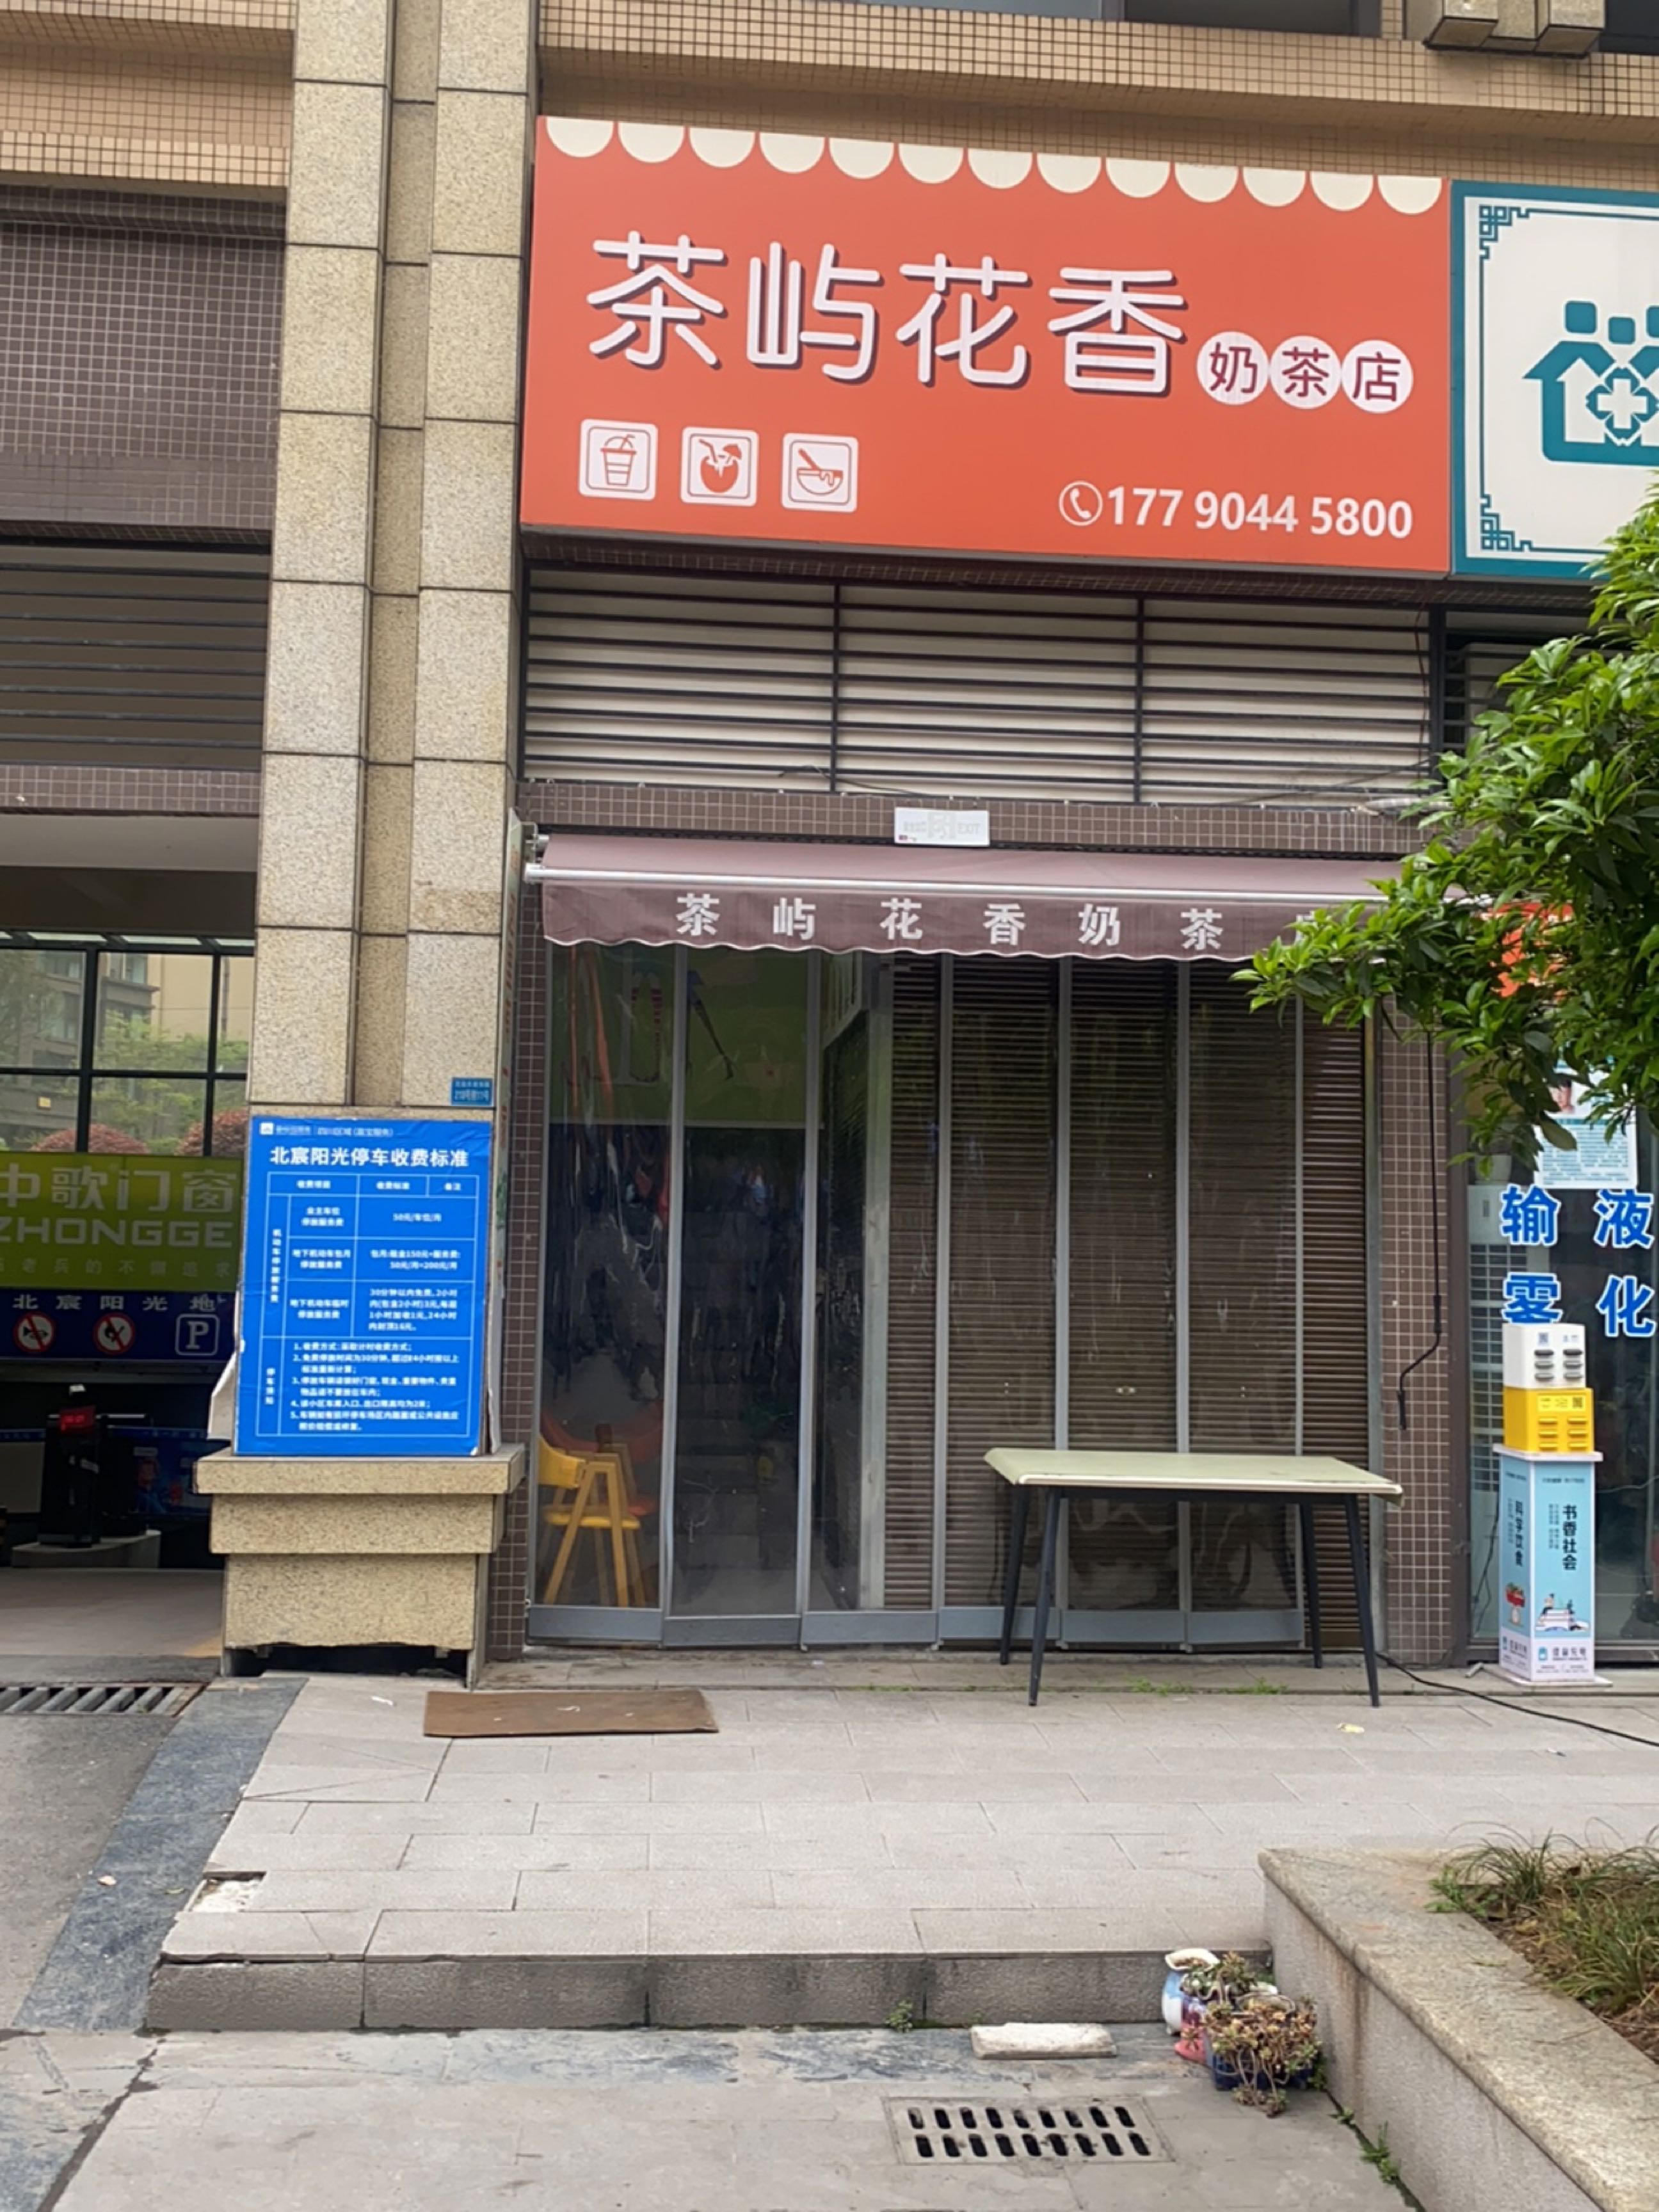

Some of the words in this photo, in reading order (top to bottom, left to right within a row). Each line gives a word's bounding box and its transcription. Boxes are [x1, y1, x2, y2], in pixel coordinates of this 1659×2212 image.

[587, 231, 1185, 394] 茶屿花香
[1207, 342, 1403, 405] 奶茶店
[1106, 485, 1181, 527] 177
[1193, 491, 1297, 533] 9044
[1308, 497, 1413, 539] 5800
[675, 894, 1320, 952] 茶屿花香奶茶
[270, 1146, 468, 1167] 北宸阳光停车收费标准
[0, 1163, 236, 1214] 中歌门窗
[1500, 1184, 1655, 1248] 输液
[0, 1216, 234, 1248] ZHONGGE
[1502, 1271, 1656, 1338] 雾化
[1562, 1504, 1578, 1571] 书香社会
